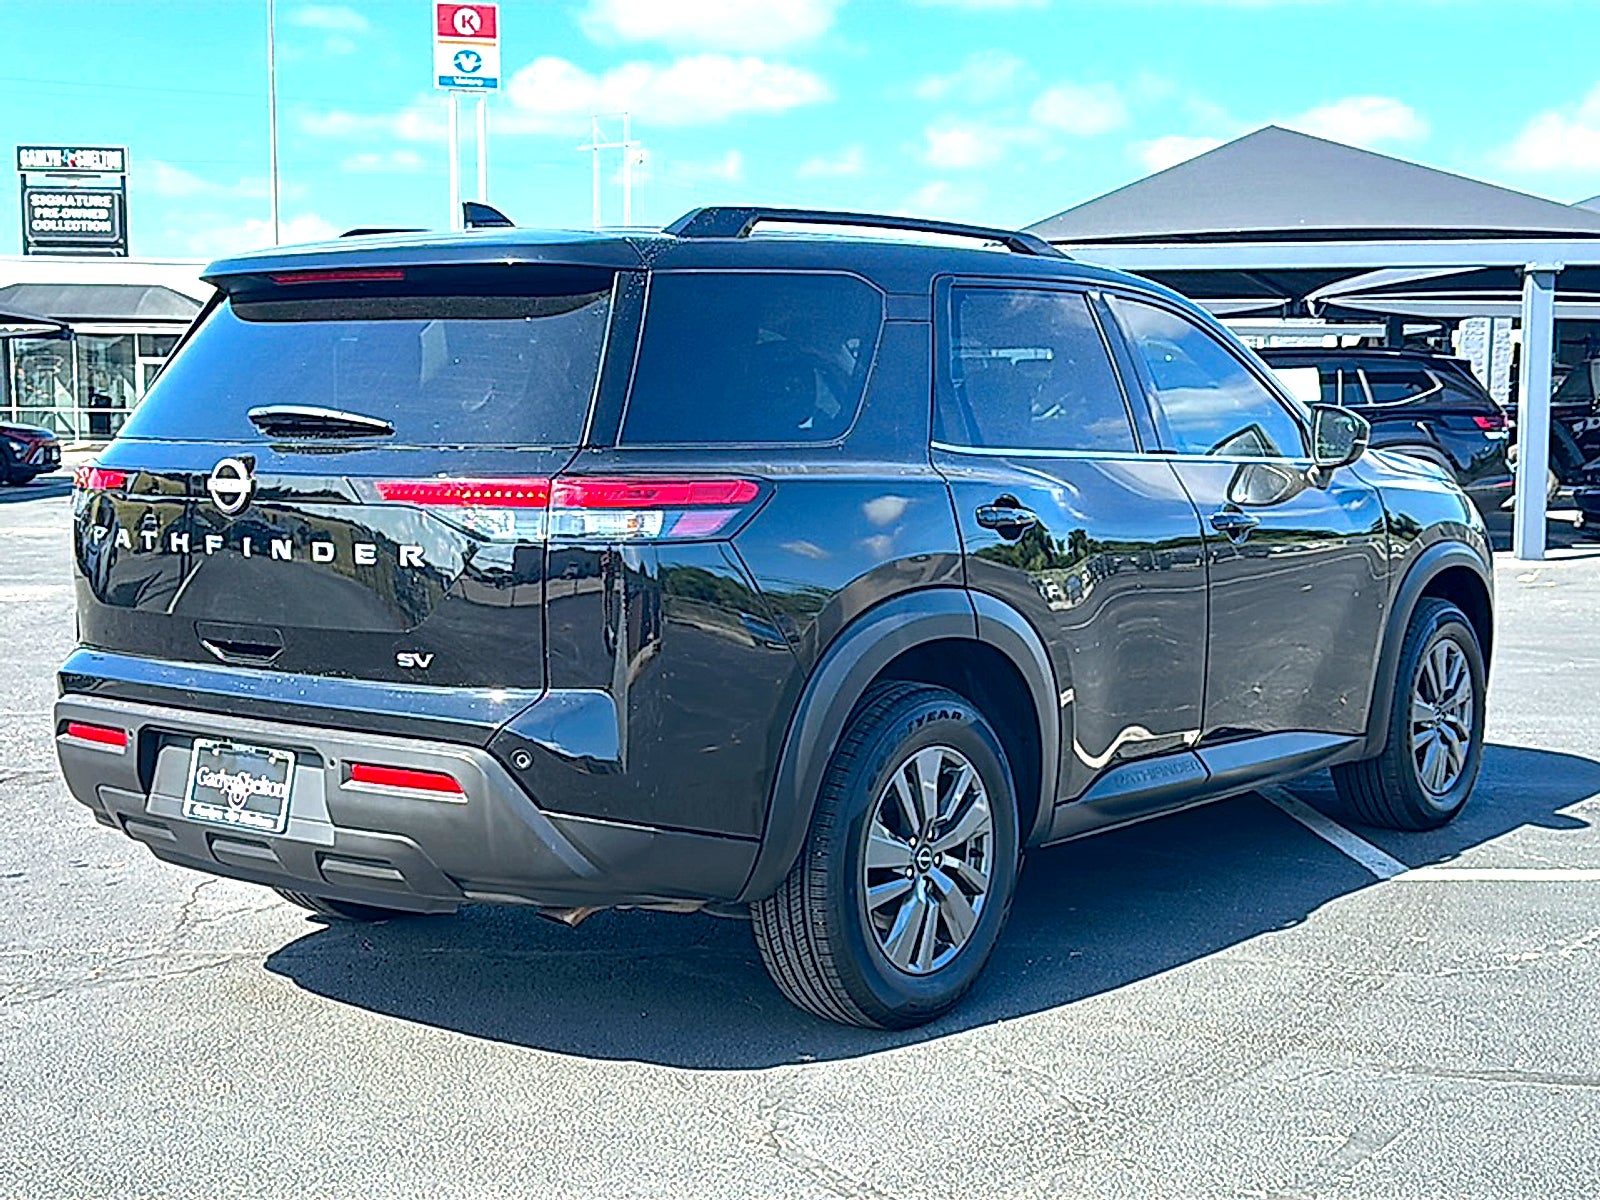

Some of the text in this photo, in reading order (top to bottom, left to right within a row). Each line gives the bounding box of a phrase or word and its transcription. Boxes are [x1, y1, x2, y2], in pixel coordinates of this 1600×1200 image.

[30, 194, 112, 207] SIGNATURE
[31, 219, 111, 231] COLLECTION
[93, 524, 425, 567] PATHFINDER
[396, 652, 432, 669] SV
